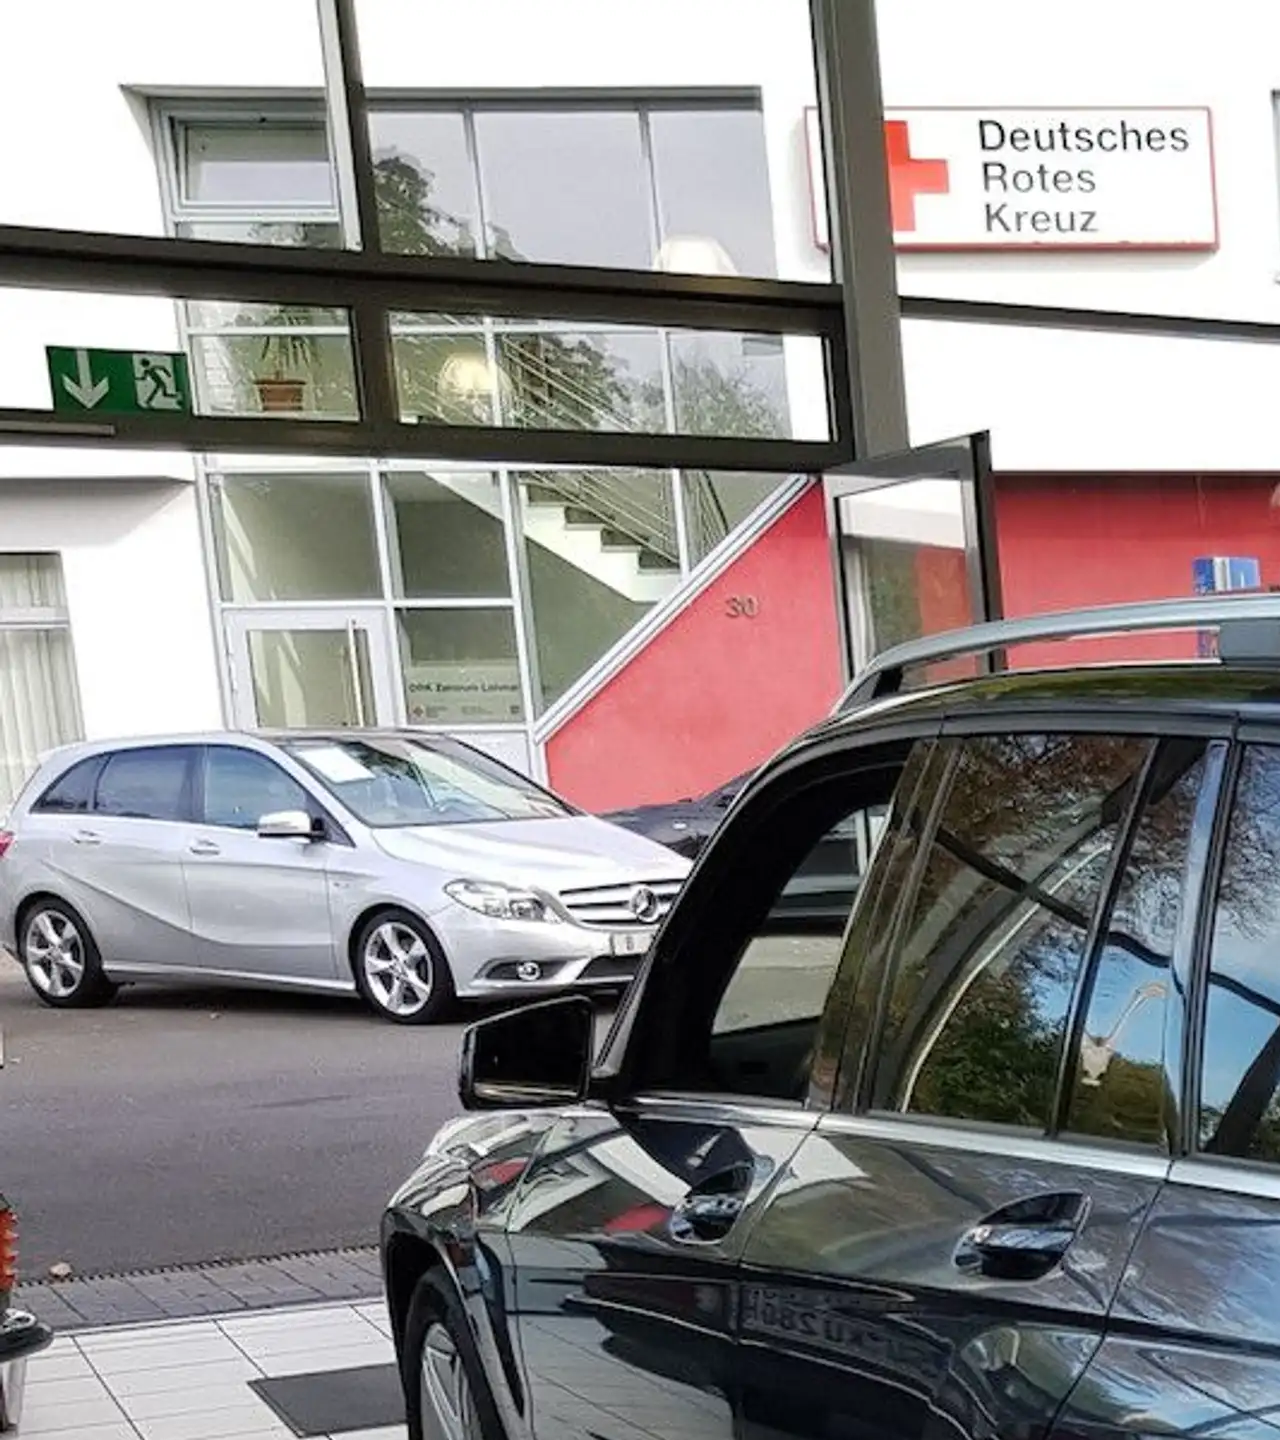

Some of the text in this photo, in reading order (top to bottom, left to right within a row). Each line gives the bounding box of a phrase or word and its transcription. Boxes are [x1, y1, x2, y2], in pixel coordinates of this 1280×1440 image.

[978, 119, 1190, 152] Deutsches
[982, 161, 1096, 193] Rotes
[985, 203, 1099, 233] Kreuz
[725, 596, 760, 619] 30
